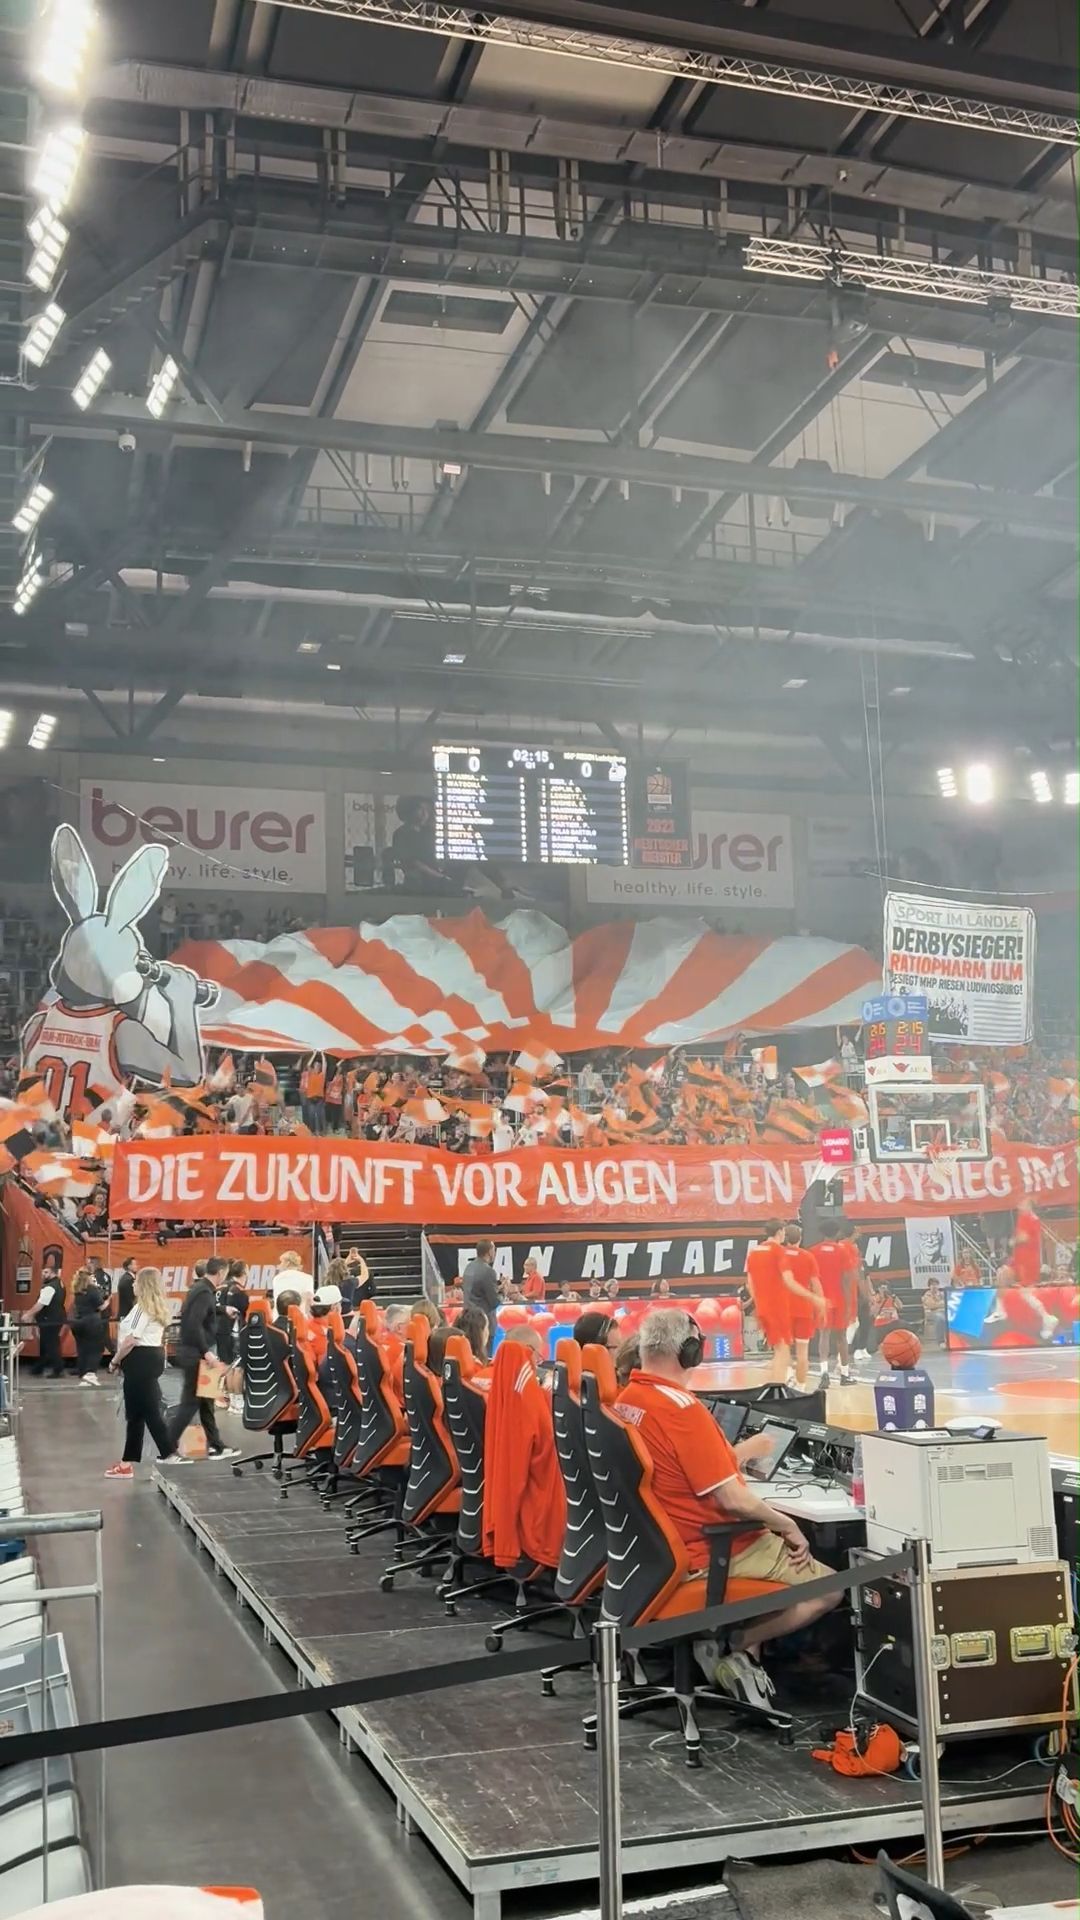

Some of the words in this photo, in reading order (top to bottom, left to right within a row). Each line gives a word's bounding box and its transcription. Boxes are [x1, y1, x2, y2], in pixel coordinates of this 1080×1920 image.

[468, 755, 481, 773] 0
[512, 749, 550, 763] 02:15
[581, 761, 593, 778] 0
[91, 788, 315, 854] beurer
[200, 863, 235, 879] life.
[241, 866, 294, 883] style.
[613, 879, 681, 898] healthy.
[687, 882, 718, 897] life.
[723, 884, 767, 899] style.
[896, 905, 942, 925] SPORT
[946, 912, 963, 925] IM
[966, 911, 1018, 928] LÄNDLE
[892, 926, 1024, 961] DERBYSIEGER!
[890, 953, 986, 980] RATIOPHARM
[991, 962, 1023, 981] ULM
[919, 977, 938, 989] MHP
[939, 979, 965, 992] RIESEN
[966, 981, 1023, 996] LUDWIGSBURG!
[896, 1021, 924, 1035] 2:15
[127, 1151, 204, 1203] DIE
[216, 1151, 423, 1205] ZUKUNFT
[432, 1161, 528, 1207] VOR
[536, 1159, 678, 1206] AUGEN
[689, 1184, 702, 1192] -
[709, 1159, 793, 1205] DEN
[1017, 1151, 1071, 1193] IM
